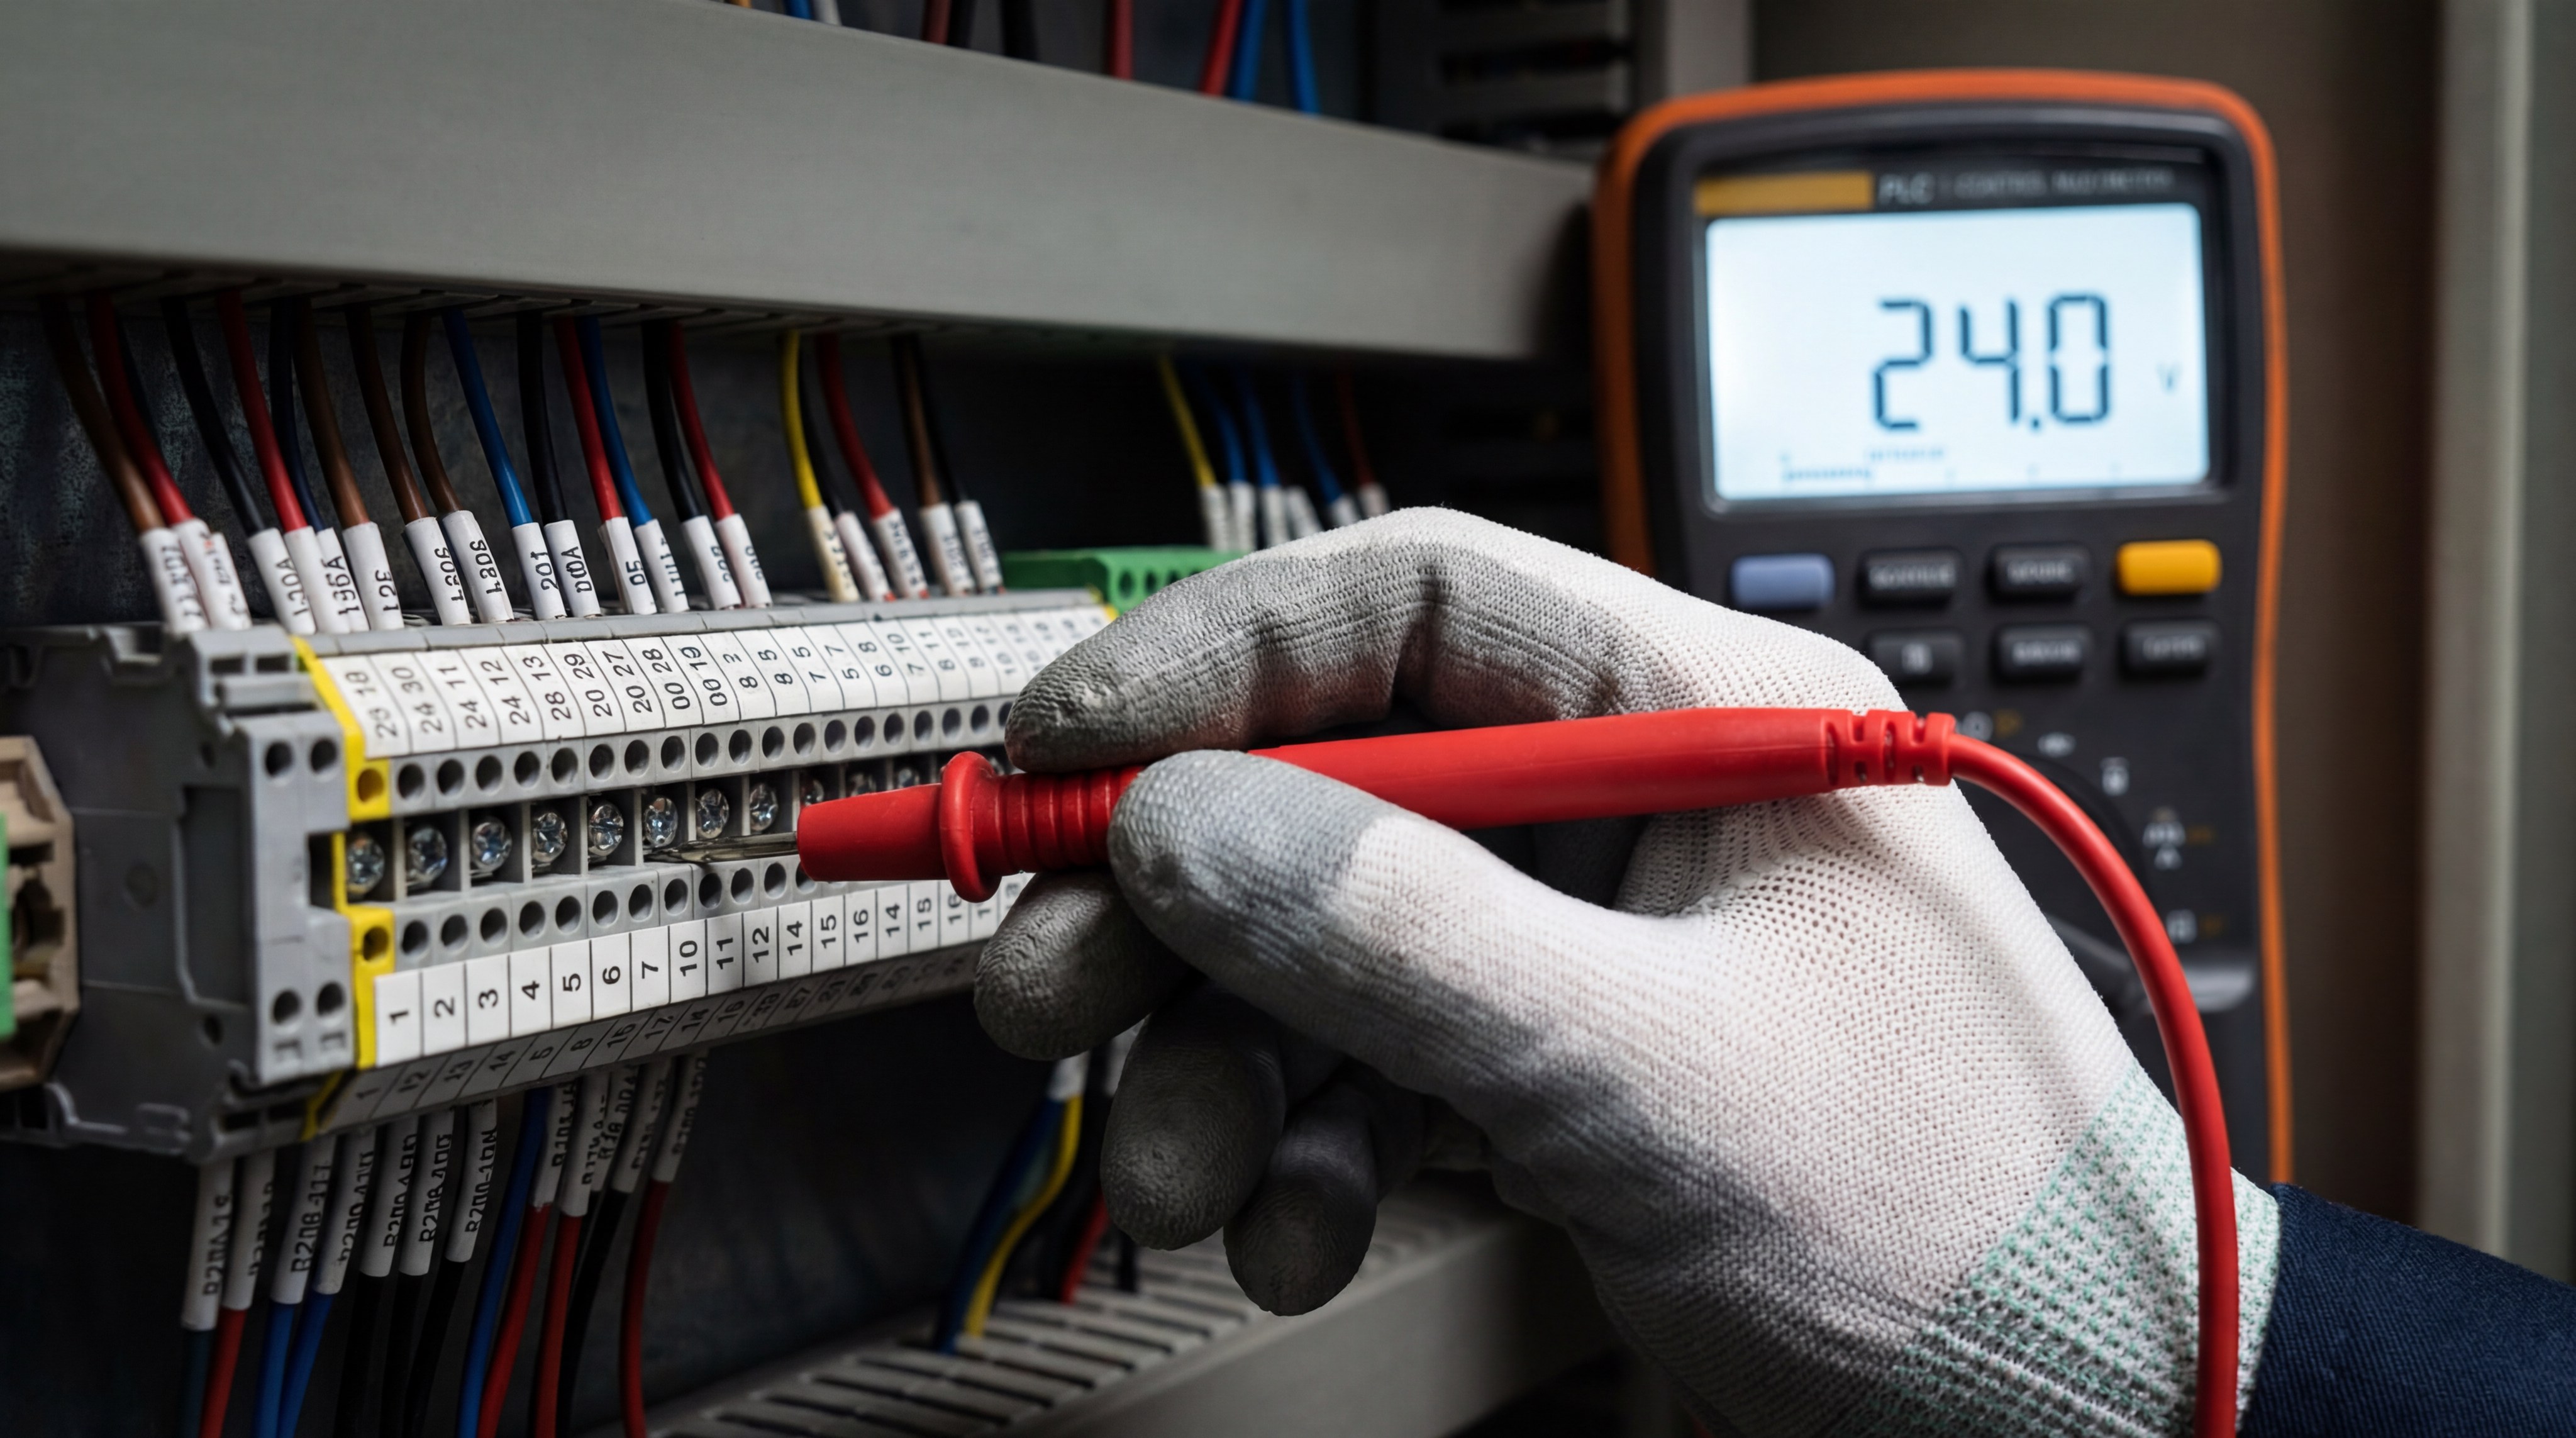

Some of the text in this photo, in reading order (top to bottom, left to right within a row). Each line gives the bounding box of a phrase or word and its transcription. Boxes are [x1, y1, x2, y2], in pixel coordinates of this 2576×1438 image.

[1873, 293, 2111, 431] 24.0
[792, 647, 811, 658] 5
[858, 641, 892, 677] 6 8
[887, 633, 910, 653] 10
[523, 656, 571, 720] 28 13
[564, 653, 613, 717] 20 29
[602, 650, 652, 713] 20 27
[642, 648, 691, 710] 00 28
[739, 676, 758, 688] 8
[841, 668, 859, 679] 5
[438, 666, 487, 729] 24 11
[480, 660, 530, 725] 24 12
[853, 909, 869, 943] 16
[886, 903, 901, 937] 14
[918, 898, 932, 931] 15
[752, 926, 769, 963] 12
[787, 920, 802, 956] 14
[821, 915, 836, 949] 15
[680, 940, 697, 976] 10
[716, 937, 733, 969] 11
[563, 973, 581, 991] 5
[602, 966, 620, 984] 6
[642, 961, 658, 979] 7
[435, 996, 454, 1018] 2
[479, 989, 498, 1009] 3
[522, 981, 540, 1000] 4
[389, 1009, 409, 1023] 1
[529, 1045, 555, 1061] 5
